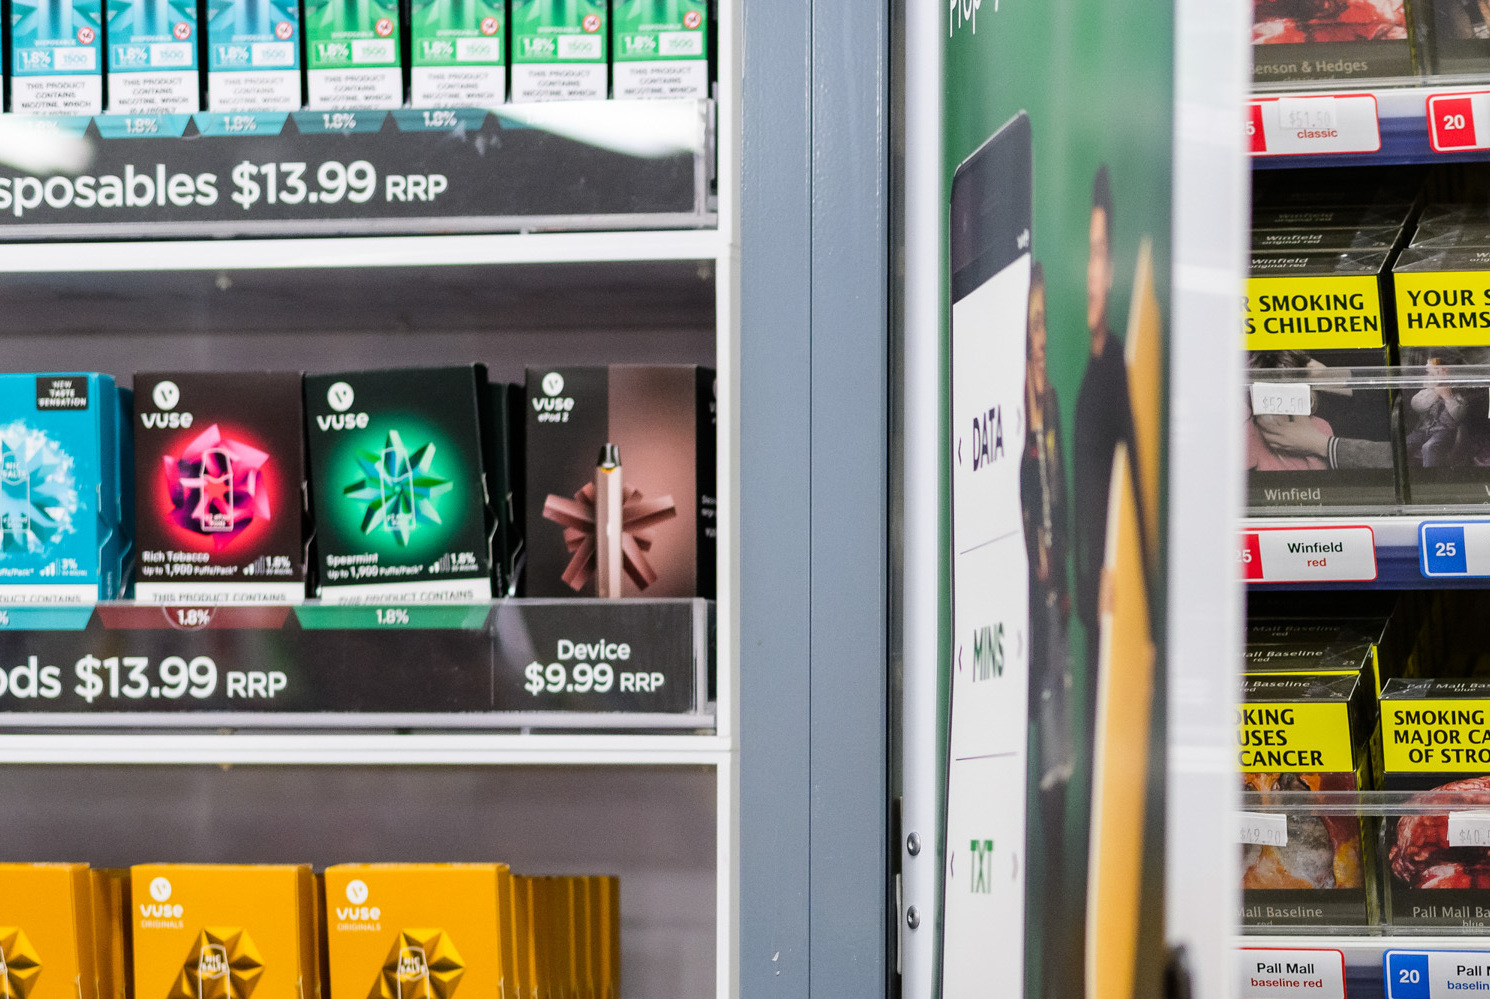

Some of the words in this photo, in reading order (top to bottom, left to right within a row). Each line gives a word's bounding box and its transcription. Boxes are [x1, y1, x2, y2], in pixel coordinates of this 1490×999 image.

[1302, 60, 1312, 72] &
[1316, 59, 1368, 73] Hedges
[125, 118, 157, 133] 1.8%
[323, 113, 356, 129] 1.8%
[1443, 115, 1465, 130] 20
[1297, 128, 1338, 139] classic
[232, 161, 376, 209] $13.99
[386, 175, 448, 202] RRP
[1259, 294, 1363, 312] SMOKING
[1407, 290, 1475, 307] YOUR
[1264, 315, 1378, 334] CHILDREN
[1407, 311, 1490, 329] HARMS
[53, 381, 72, 389] NEW
[50, 389, 75, 397] TASTE
[38, 397, 86, 407] SENSATION
[532, 398, 574, 411] vuse
[1263, 397, 1304, 412] $52.50
[141, 413, 193, 429] vuse
[317, 412, 369, 431] vuse
[973, 404, 1004, 472] DATA
[1264, 488, 1321, 500] Winfield
[1287, 541, 1343, 553] Winfield
[1435, 543, 1456, 556] 25
[143, 552, 162, 562] Rich
[167, 552, 210, 562] Tobacco
[265, 557, 291, 568] 1.8%
[327, 553, 378, 567] Spearmint
[1307, 557, 1326, 567] red
[376, 610, 409, 624] 1.8%
[558, 639, 630, 660] Device
[75, 655, 218, 703] $13.99
[227, 672, 287, 698] RRP
[524, 662, 614, 695] $9.99
[620, 672, 664, 692] RRP
[1394, 710, 1484, 726] SMOKING
[1394, 729, 1460, 748] MAJOR
[1238, 750, 1324, 766] CANCER
[1408, 749, 1434, 763] OF
[140, 904, 183, 918] vuse
[337, 907, 380, 921] vuse
[1413, 907, 1435, 918] Pall
[1439, 907, 1470, 918] Mall
[1257, 962, 1282, 974] Pall
[1286, 963, 1315, 974] Mall
[1456, 965, 1482, 977] Pall
[1251, 977, 1300, 988] baseline
[1303, 978, 1323, 988] red
[1399, 969, 1420, 983] 20
